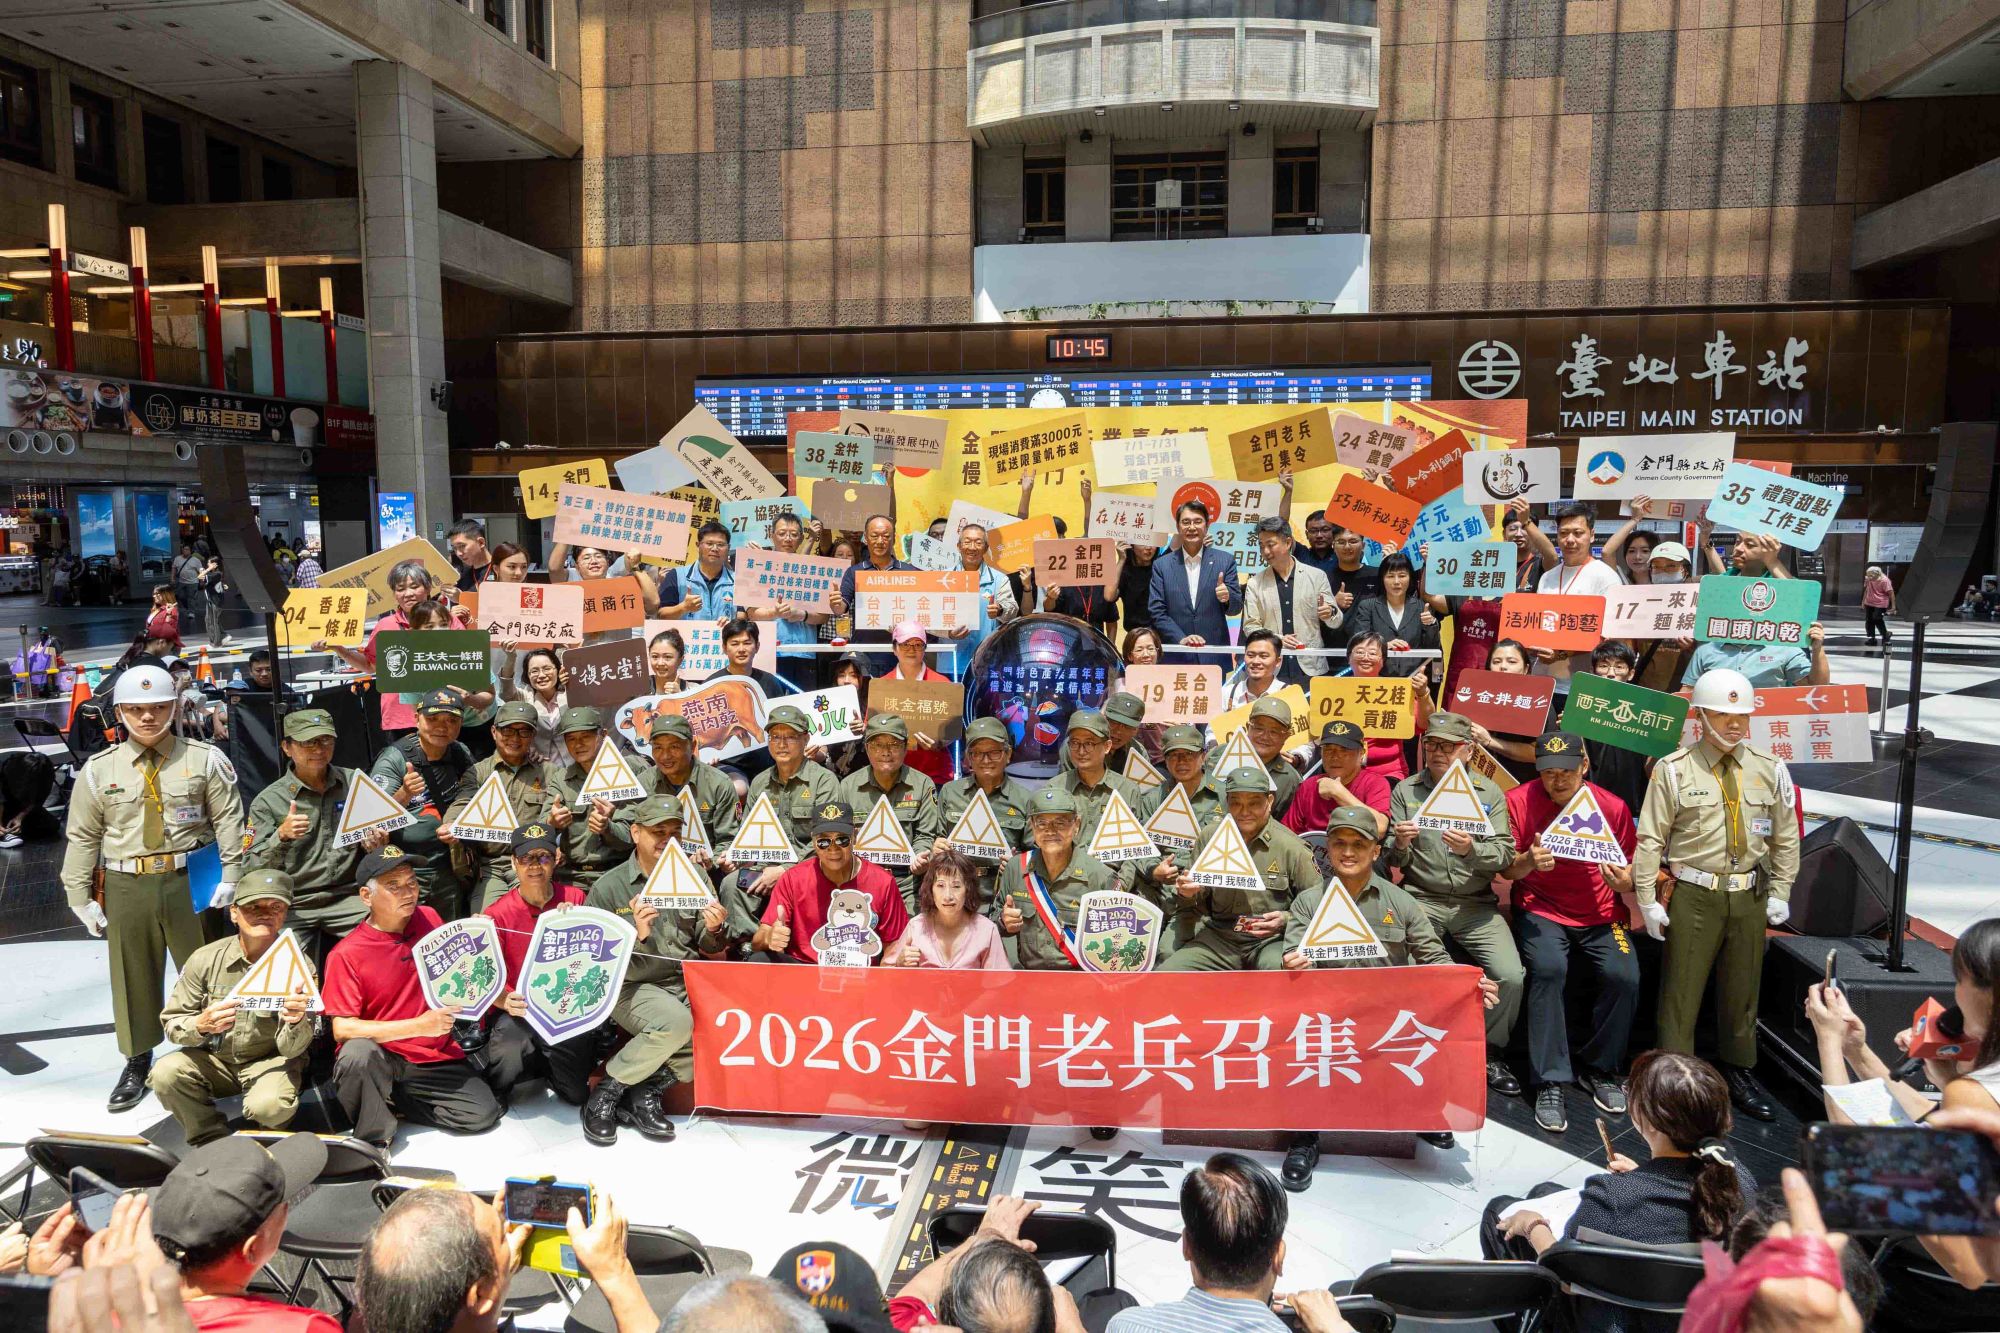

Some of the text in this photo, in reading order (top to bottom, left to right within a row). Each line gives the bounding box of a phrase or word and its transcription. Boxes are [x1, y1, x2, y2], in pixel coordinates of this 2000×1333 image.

[1055, 339, 1105, 357] 10:45
[1556, 330, 1809, 400] 臺北車站
[183, 408, 260, 428] 鮮奶茶三冠王
[1560, 407, 1803, 428] TAIPEI MAIN STATION
[988, 423, 1083, 459] 現場消費滿3000元
[1249, 419, 1312, 453] 金門老兵
[1338, 432, 1361, 450] 24
[1368, 429, 1408, 452] 金門縣
[805, 448, 826, 464] 38
[996, 441, 1080, 475] 就送限量帆布袋
[1262, 445, 1308, 473] 召集令
[1365, 449, 1394, 469] 農會
[1636, 453, 1726, 473] 金門縣政府
[827, 459, 864, 476] 牛肉乾
[1660, 475, 1683, 483] County
[1808, 472, 1849, 483] Machine
[529, 483, 549, 501] 14
[1226, 488, 1262, 508] 金門
[1722, 482, 1755, 506] 35
[1761, 483, 1834, 518] 禮賀甜點
[731, 516, 748, 533] 27
[1759, 507, 1814, 537] 工作室
[1106, 530, 1151, 542] SINCE 1832
[1214, 530, 1236, 547] 32
[1075, 544, 1103, 560] 金門
[1470, 549, 1499, 568] 金門
[1048, 555, 1067, 571] 22
[1436, 558, 1458, 576] 30
[866, 575, 916, 586] AIRLINES
[1462, 571, 1506, 589] 蟹老闆
[319, 595, 353, 616] 香蜂
[867, 595, 957, 611] 台北金門
[1615, 602, 1639, 619] 17
[284, 607, 307, 626] 04
[308, 618, 359, 638] 一條根
[487, 620, 576, 639] 金門陶瓷廠
[1706, 617, 1801, 643] 圓頭肉乾
[413, 651, 483, 663] 王大夫一條根
[413, 661, 483, 671] DR.WANG GTH
[1172, 672, 1208, 692] 長合
[1142, 684, 1165, 702] 19
[1355, 685, 1406, 706] 天之桂
[884, 696, 950, 716] 陳金福號
[1319, 697, 1344, 716] 02
[1363, 710, 1398, 730] 貢糖
[1621, 724, 1650, 738] COFFEE
[453, 826, 484, 839] 我金門
[1418, 816, 1488, 835] 我金門 我驕傲
[1544, 834, 1620, 854] 2026 金門老兵
[731, 849, 791, 862] 我金門 我驕傲
[1590, 849, 1623, 863] ONLY
[1193, 872, 1257, 889] 我金門 我驕傲
[542, 944, 599, 960] 老兵召集令
[1342, 943, 1378, 957] 我驕傲
[715, 1007, 1450, 1092] 2026金門老兵召集令
